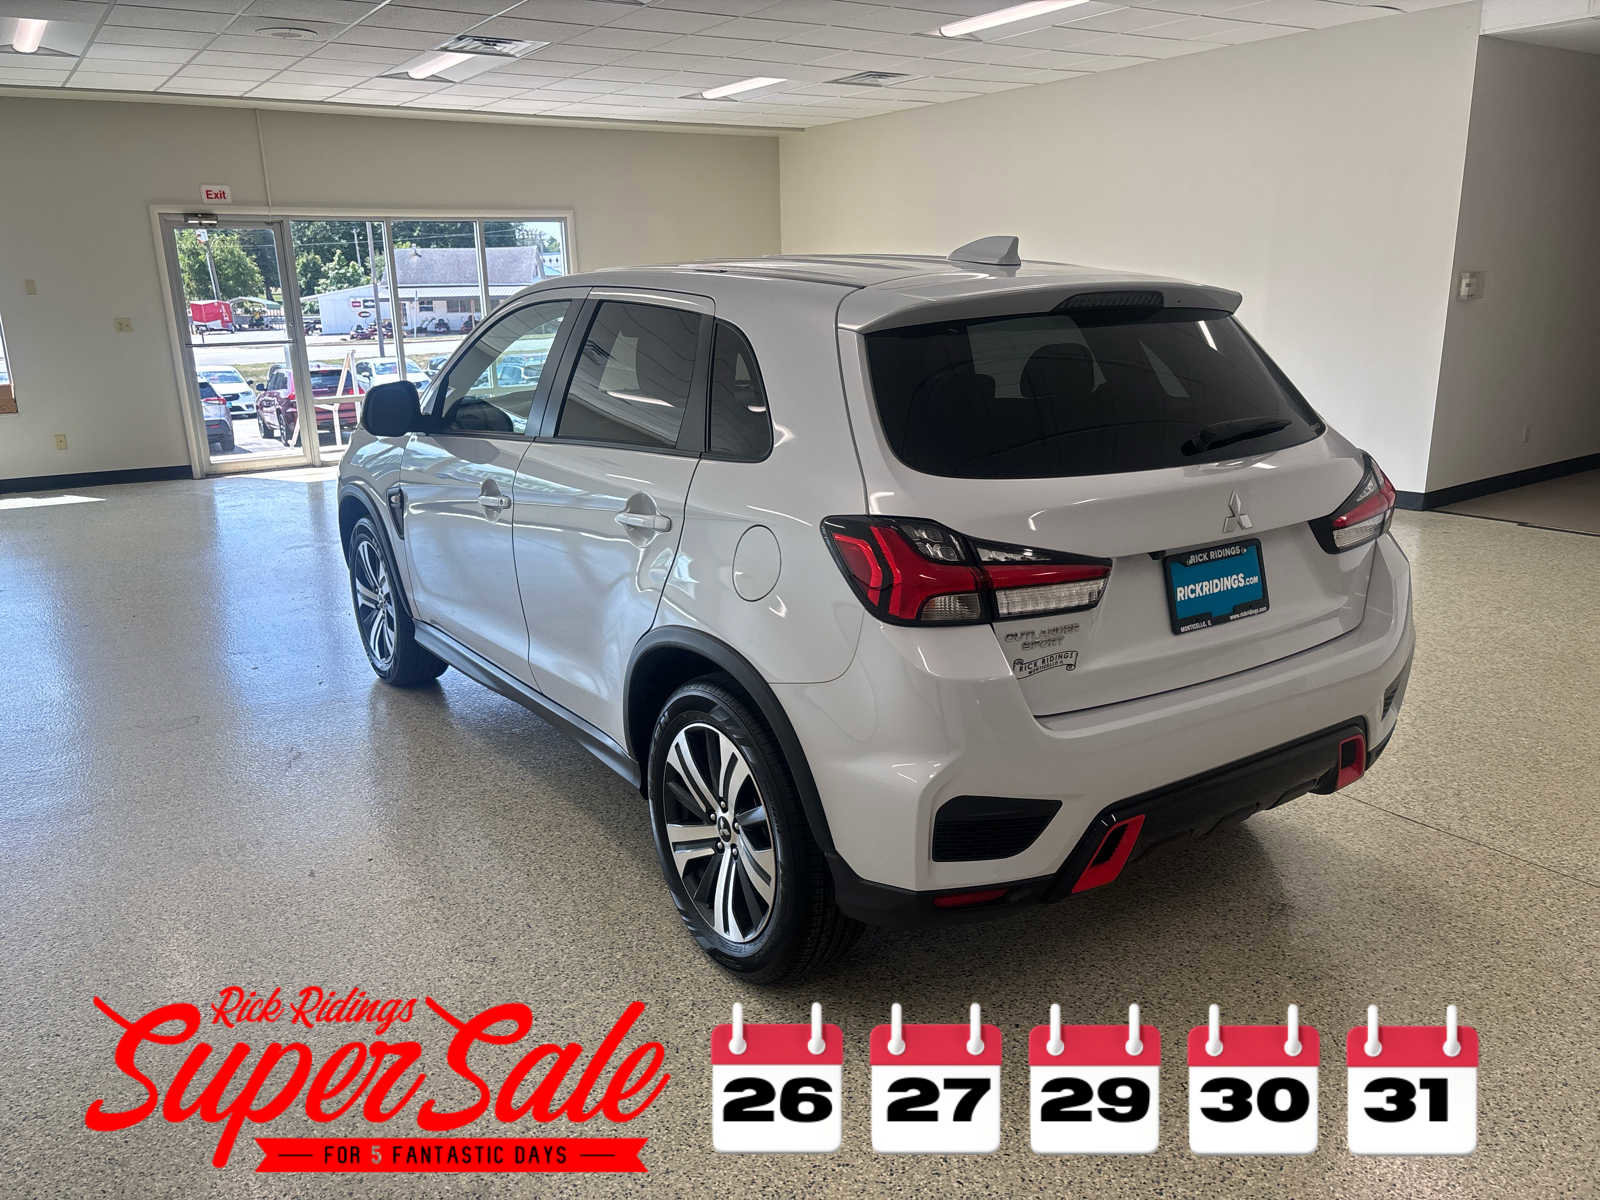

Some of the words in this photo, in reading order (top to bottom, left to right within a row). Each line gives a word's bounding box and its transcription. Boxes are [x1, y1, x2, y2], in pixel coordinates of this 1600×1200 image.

[205, 189, 227, 200] Exit
[1190, 552, 1209, 564] RICK
[1210, 545, 1241, 560] RIDINGS
[1176, 572, 1259, 602] RICKRIDINGS.COM
[1019, 661, 1038, 673] RICK
[1041, 652, 1074, 664] RIDINGS
